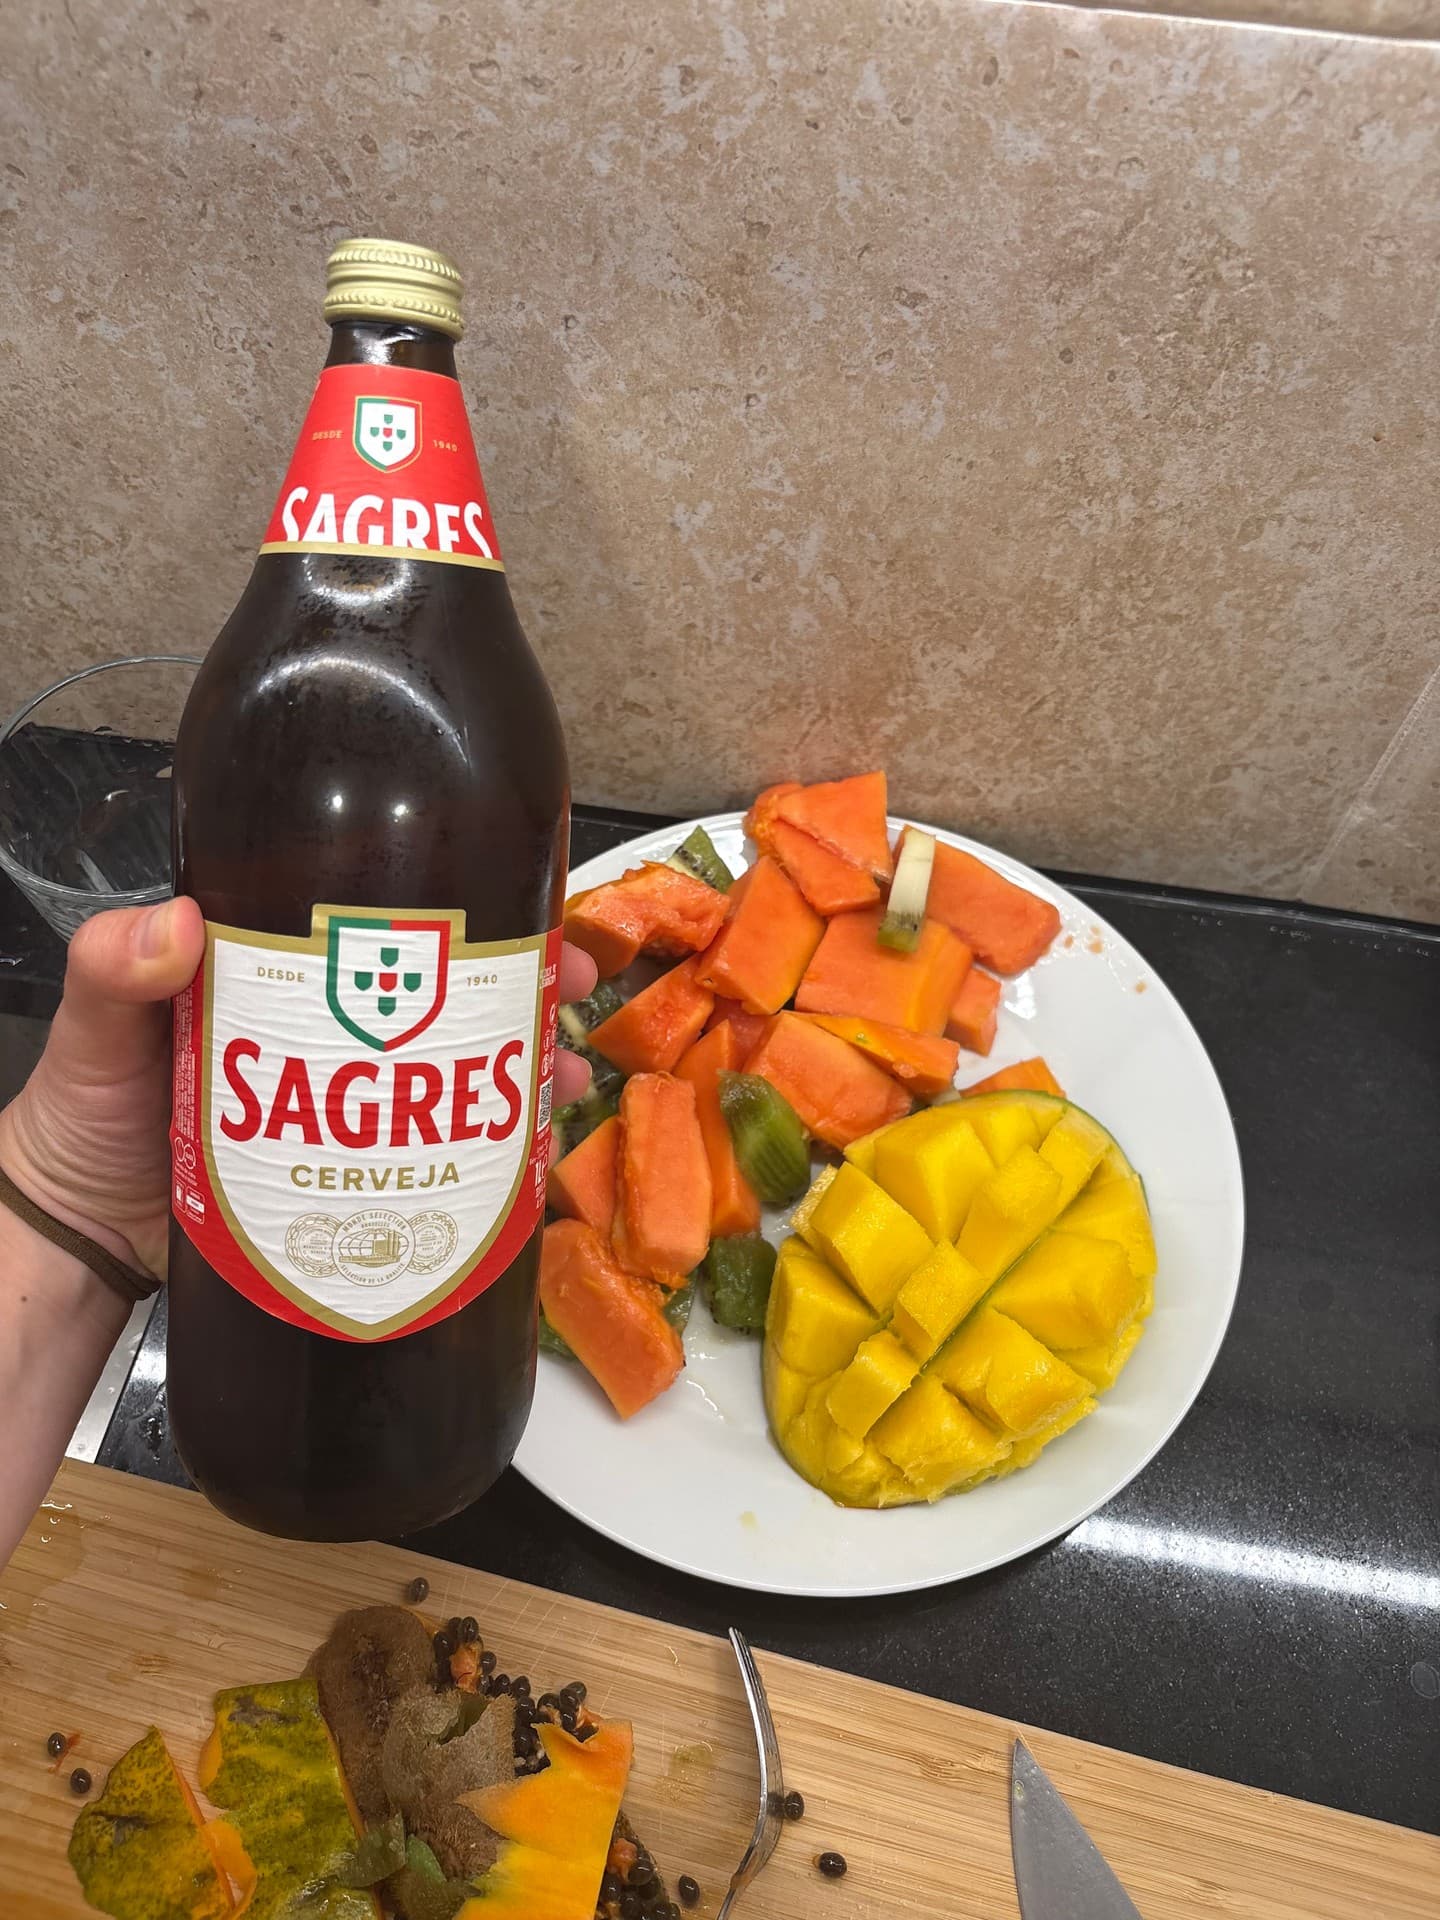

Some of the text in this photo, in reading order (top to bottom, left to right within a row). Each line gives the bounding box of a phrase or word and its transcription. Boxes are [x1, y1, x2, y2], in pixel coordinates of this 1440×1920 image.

[312, 429, 458, 452] DESDE 1940
[282, 486, 494, 559] SAGRES
[257, 965, 498, 987] DESDE 1940
[219, 1037, 525, 1149] SAGRES
[289, 1162, 461, 1191] CERVEJA
[342, 1214, 366, 1232] MONDE
